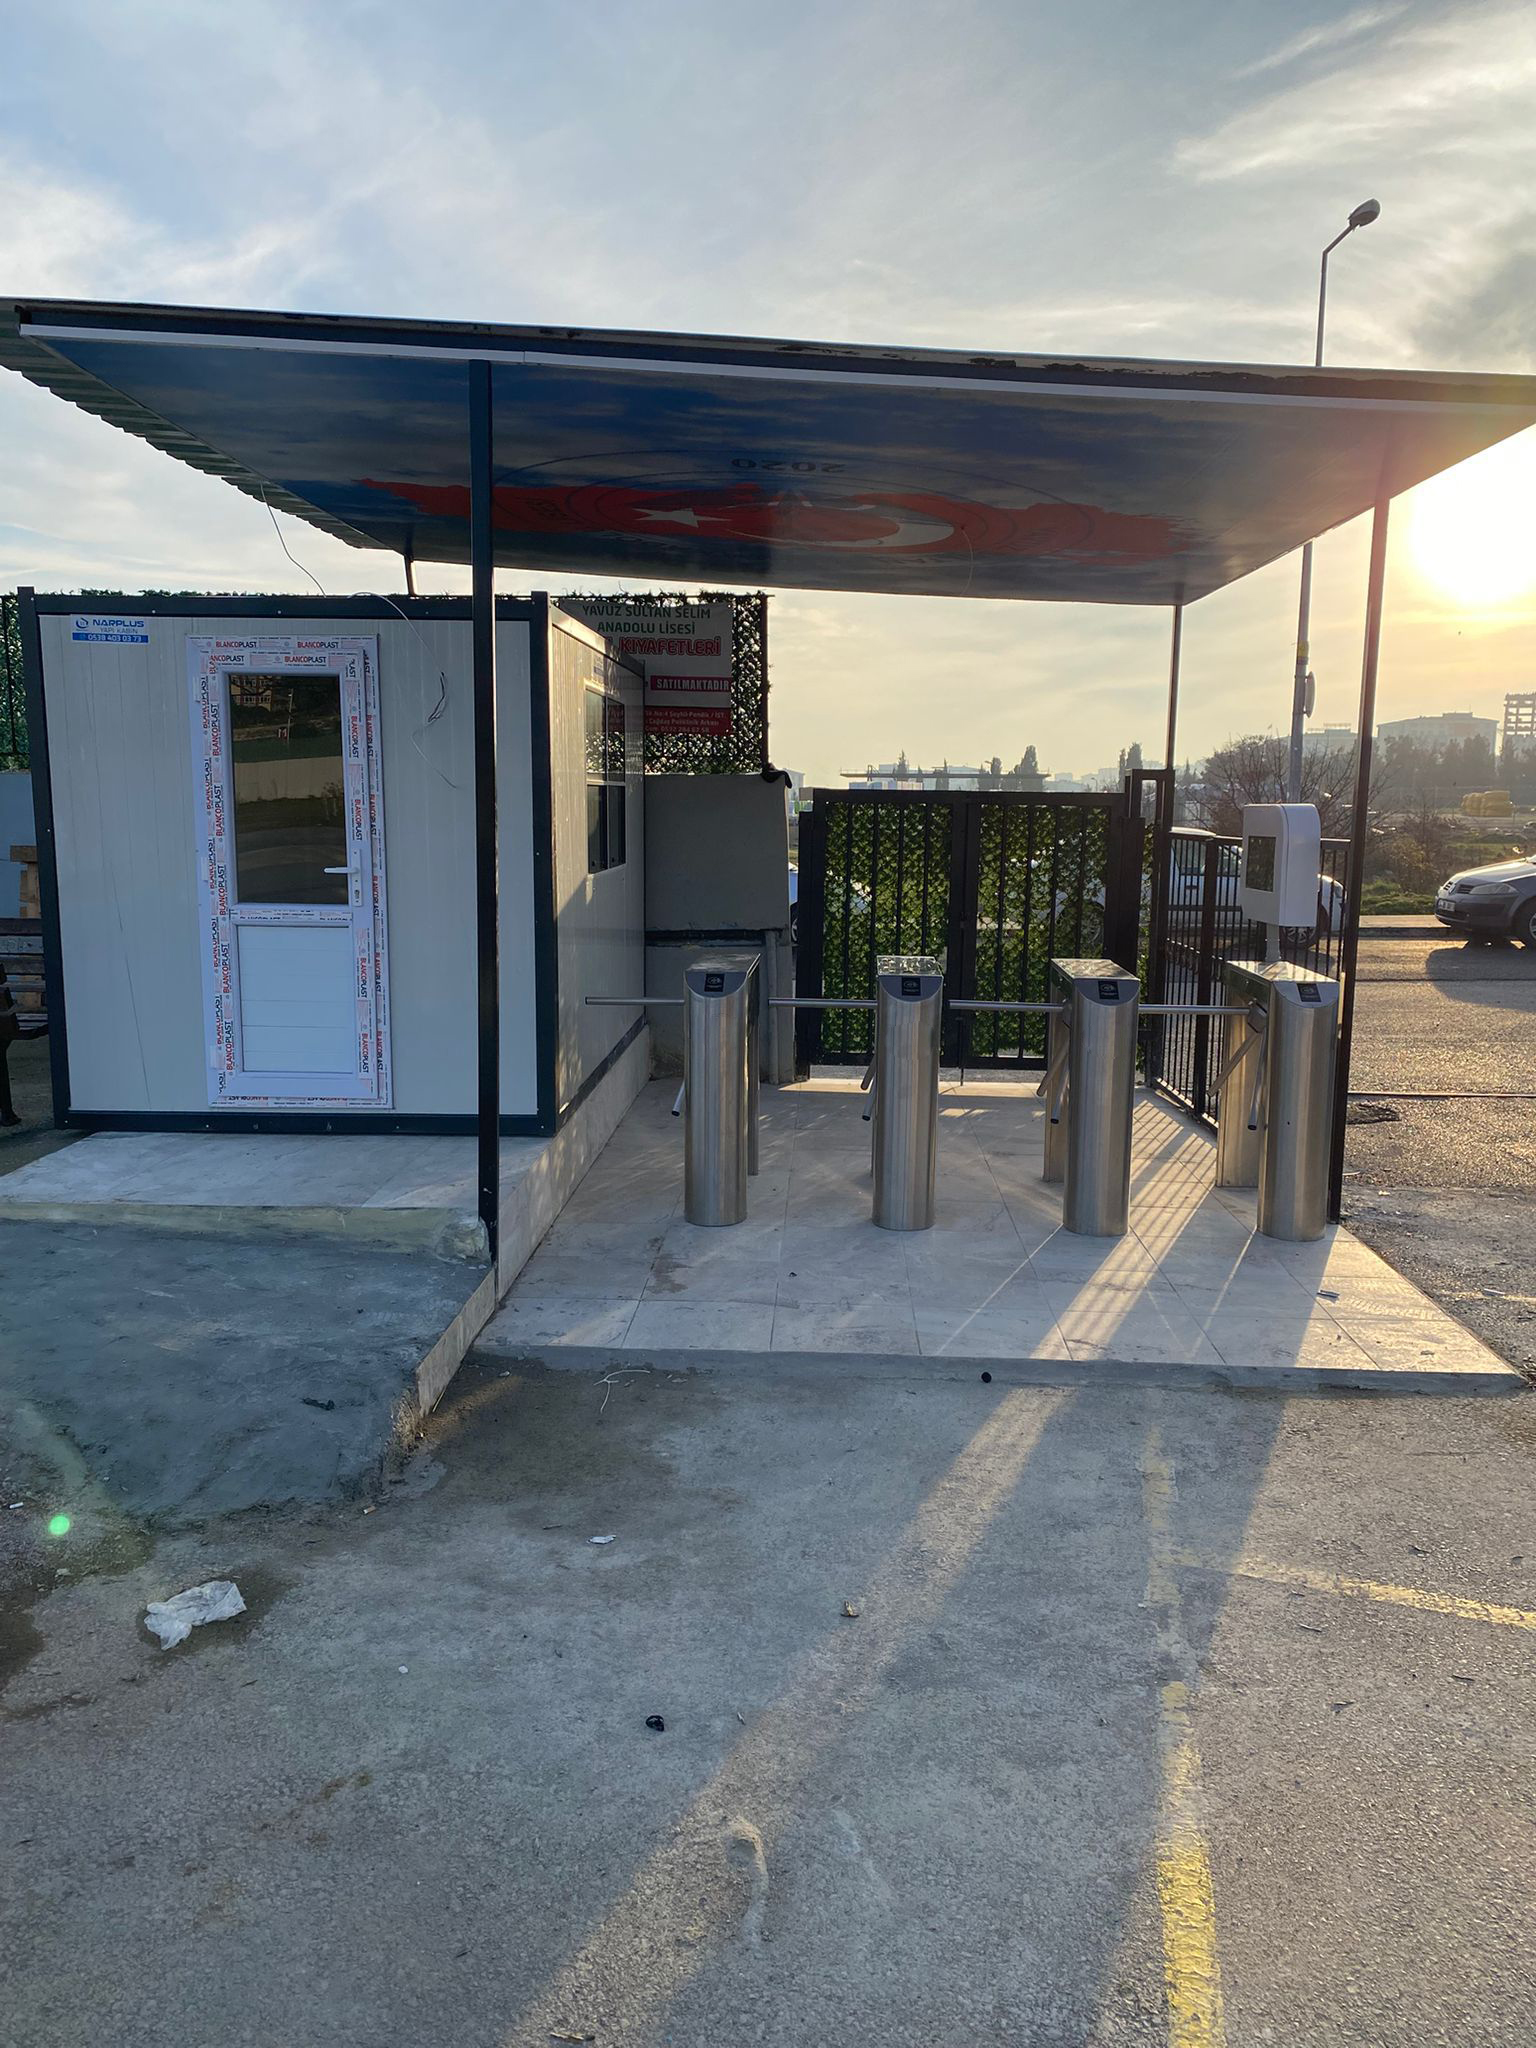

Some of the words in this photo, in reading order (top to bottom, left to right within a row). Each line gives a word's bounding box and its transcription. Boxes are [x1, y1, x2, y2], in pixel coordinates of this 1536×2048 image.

[92, 619, 144, 628] NARPLUS
[582, 605, 621, 617] YAVUZ
[626, 606, 671, 618] SULTAN
[675, 607, 711, 619] SELİM
[597, 621, 655, 634] ANADOLU
[659, 621, 695, 635] LİSESİ
[215, 641, 257, 649] BLANCOPLAST
[297, 641, 339, 649] BLANCOPLAST
[619, 636, 722, 656] KIYAFETLERİ
[656, 679, 730, 692] SATILMAKTADIR
[211, 703, 220, 756] BLANCOPLAST
[351, 715, 359, 759] BLANCOPLAST
[214, 784, 223, 837] BLANCOPLAST
[354, 799, 362, 841] BLANCOPLAST
[218, 865, 226, 915] BLANCOPLAST
[222, 943, 230, 993] BLANCOPLAST
[225, 1021, 233, 1070] BLANCOPLAST
